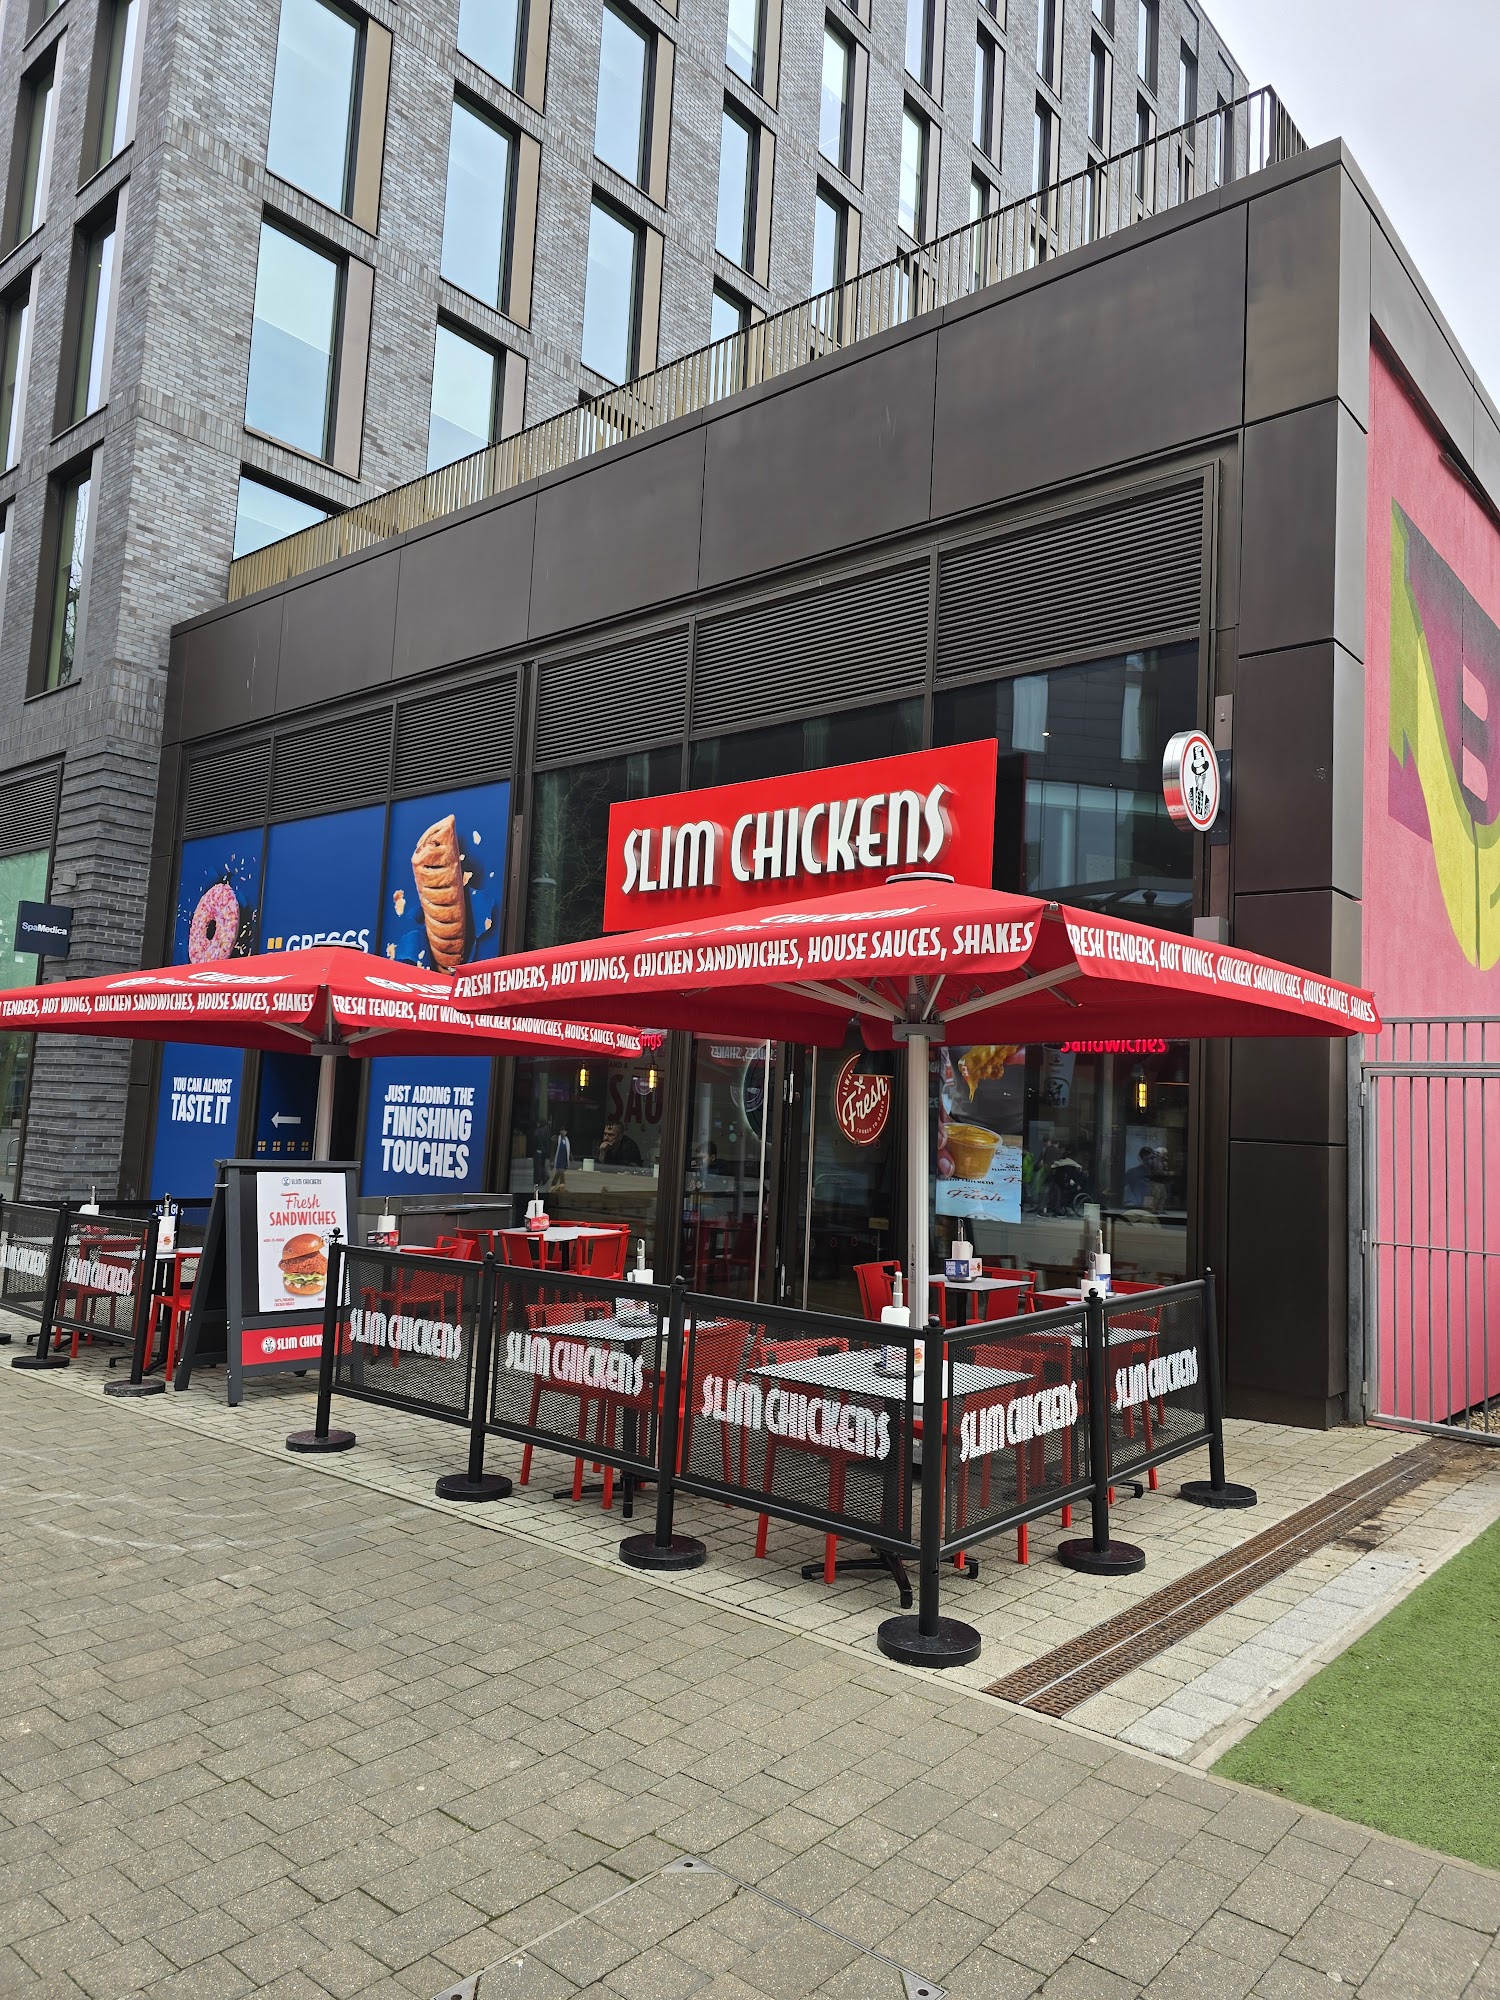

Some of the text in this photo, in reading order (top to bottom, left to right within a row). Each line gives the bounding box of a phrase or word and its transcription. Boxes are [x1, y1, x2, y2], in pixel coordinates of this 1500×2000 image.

[621, 783, 952, 896] SLIM CHICKENS
[21, 921, 68, 936] SpaMedica
[453, 921, 1036, 999] FRESH TENDERS, HOT WINGS, CHICKEN SANDWICHES, HOUSE SAUCES, SHAKES
[1066, 923, 1377, 1023] FRESH TENDERS, HOT WINGS, CHICKEN SANDWICHES, HOUSE SAUCES, SHAKES
[1, 991, 315, 1018] TENDERS, HOT WINGS, CHICKEN SANDWICHES, HOUSE SAUCES, SHAKES
[331, 994, 642, 1051] FRESH TENDERS, HOT WINGS, CHICKEN SANDWICHES, HOUSE SAUCES, SHAKES
[639, 1033, 662, 1051] ings
[173, 1076, 233, 1094] YOU CAN ALMOST
[384, 1084, 475, 1107] JUST ADDING THE
[607, 1074, 664, 1125] SAU
[842, 1076, 888, 1133] Fresh
[171, 1093, 232, 1125] TASTE IT
[382, 1104, 473, 1142] FINISHING
[381, 1138, 470, 1180] TOUCHES
[269, 1211, 337, 1227] SANDWICHES
[280, 1192, 321, 1211] Fresh
[276, 1333, 324, 1351] SLIM CHICK
[349, 1307, 463, 1361] SLIM CHICKENS
[504, 1330, 645, 1397] SLIM CHICKENS
[1114, 1363, 1147, 1411] SLIM
[701, 1373, 892, 1461] SLIM CHICKENS
[960, 1380, 1079, 1463] SLIM CHICKENS
